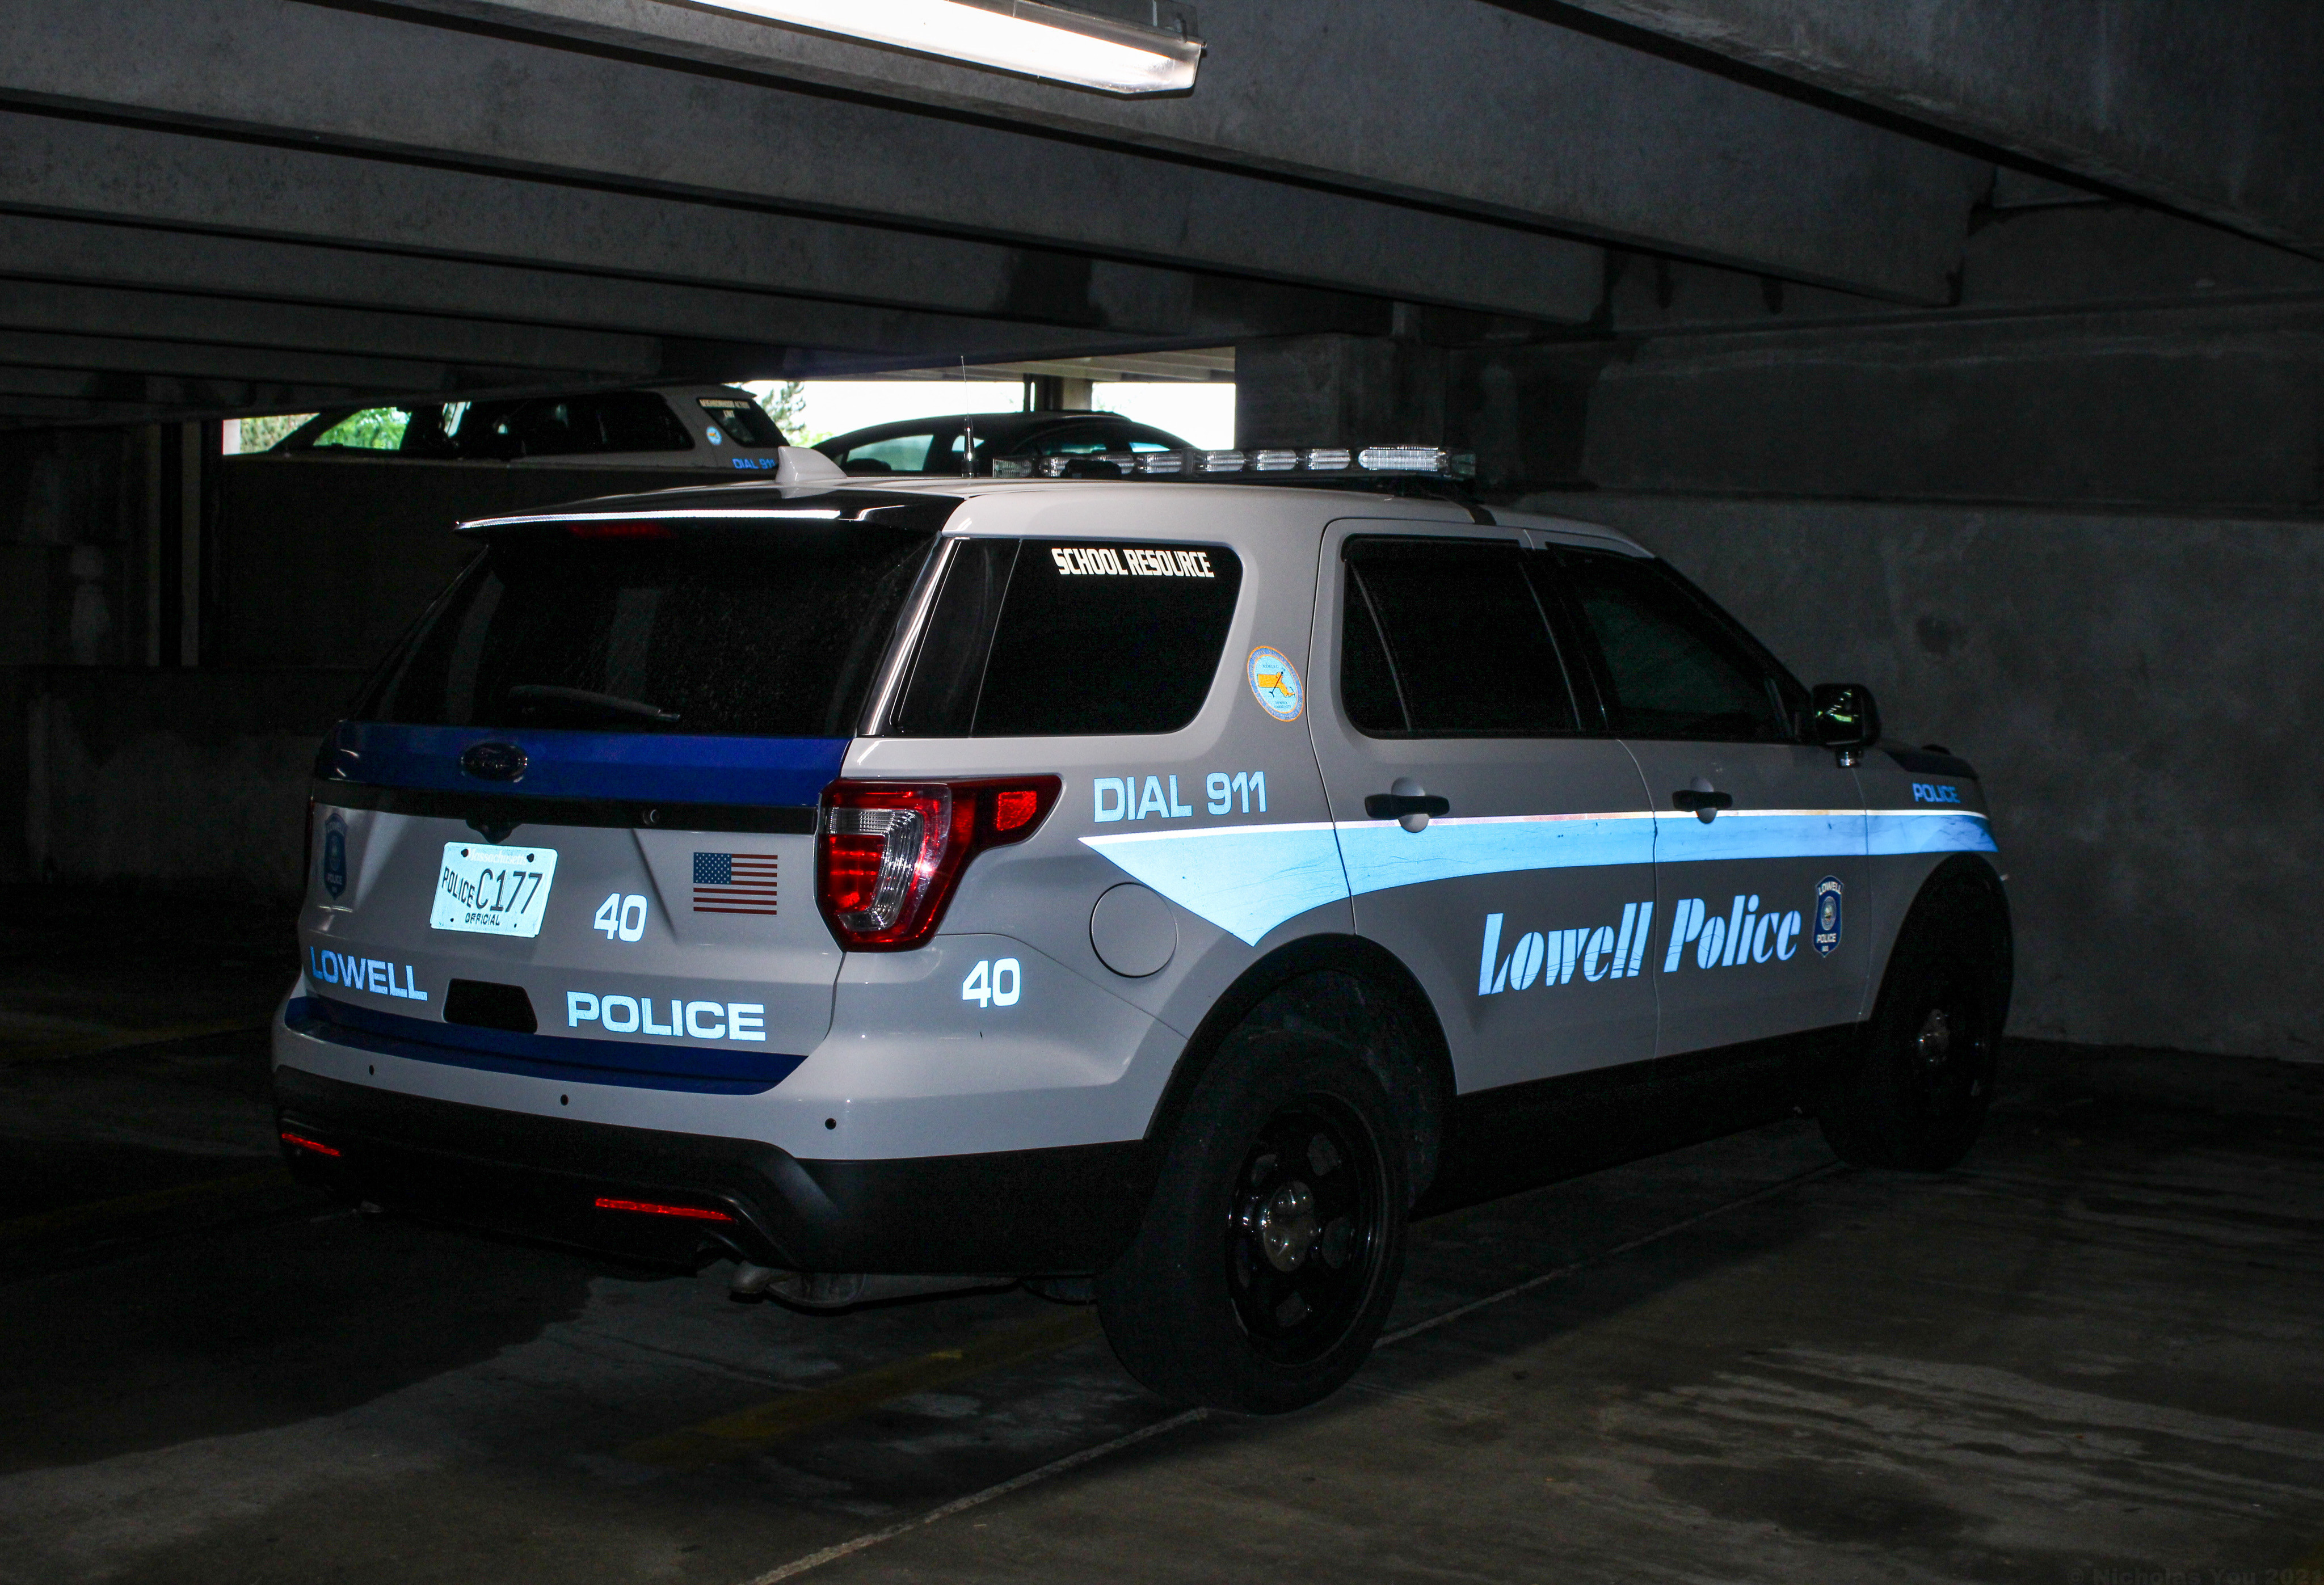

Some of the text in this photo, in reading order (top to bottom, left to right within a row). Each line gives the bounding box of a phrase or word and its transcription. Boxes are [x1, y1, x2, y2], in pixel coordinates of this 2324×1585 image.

[732, 458, 759, 469] DIAL
[1051, 547, 1215, 577] SCHOOL RESOURCE
[1094, 771, 1266, 823] DIAL 911
[1913, 783, 1961, 803] POLICE
[441, 866, 475, 908] POLICE
[476, 868, 543, 914] C177
[1818, 881, 1842, 896] LOWELL
[465, 912, 500, 926] OFFICIAL
[593, 893, 648, 943] 40
[1816, 933, 1837, 943] POLICE
[1479, 894, 1801, 996] Lowell Police
[310, 946, 428, 1002] LOWELL
[962, 958, 1021, 1009] 40
[566, 990, 767, 1043] POLICE
